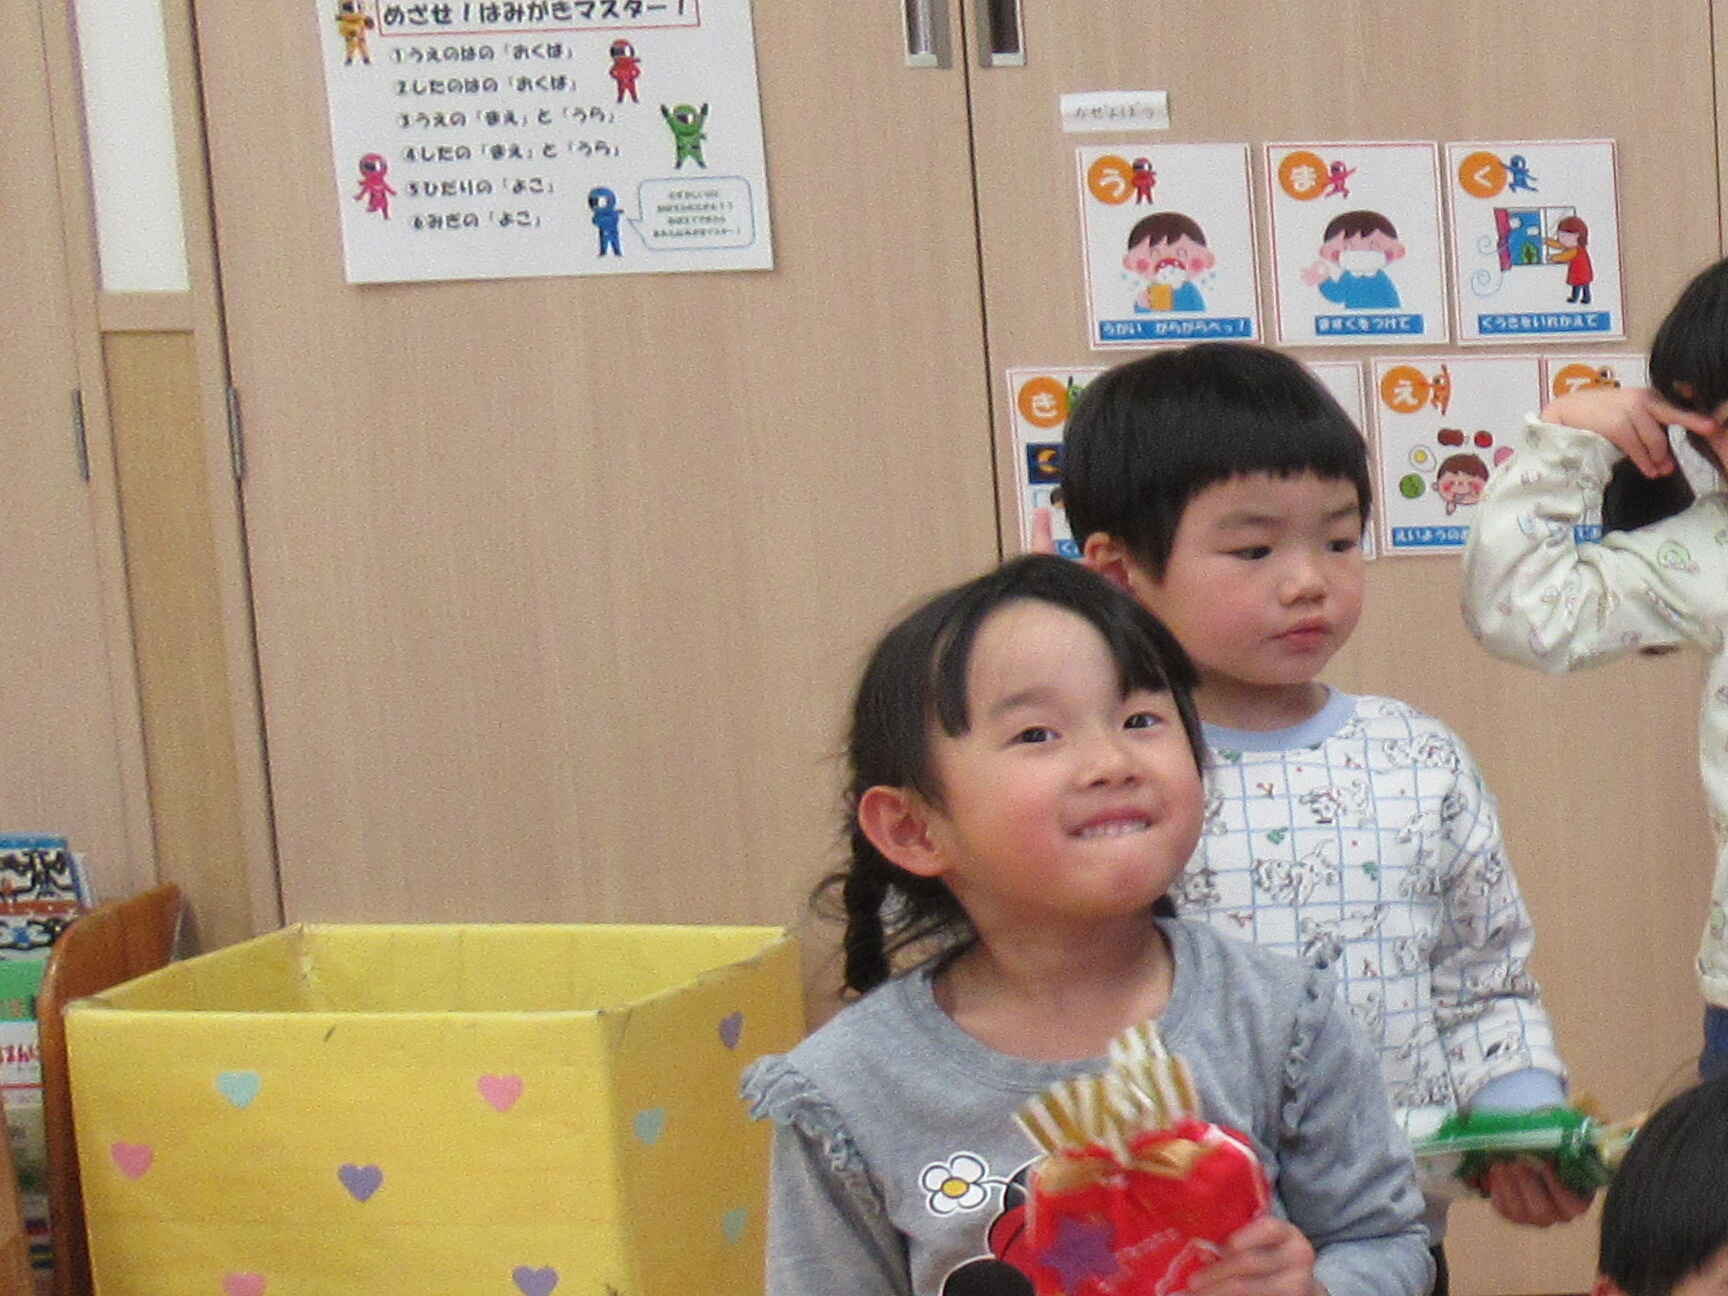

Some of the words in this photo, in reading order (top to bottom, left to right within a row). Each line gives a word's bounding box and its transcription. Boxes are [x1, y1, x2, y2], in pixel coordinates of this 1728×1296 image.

[1099, 168, 1126, 198] う
[1290, 164, 1317, 191] ま
[1473, 165, 1492, 188] く
[1390, 379, 1417, 404] え
